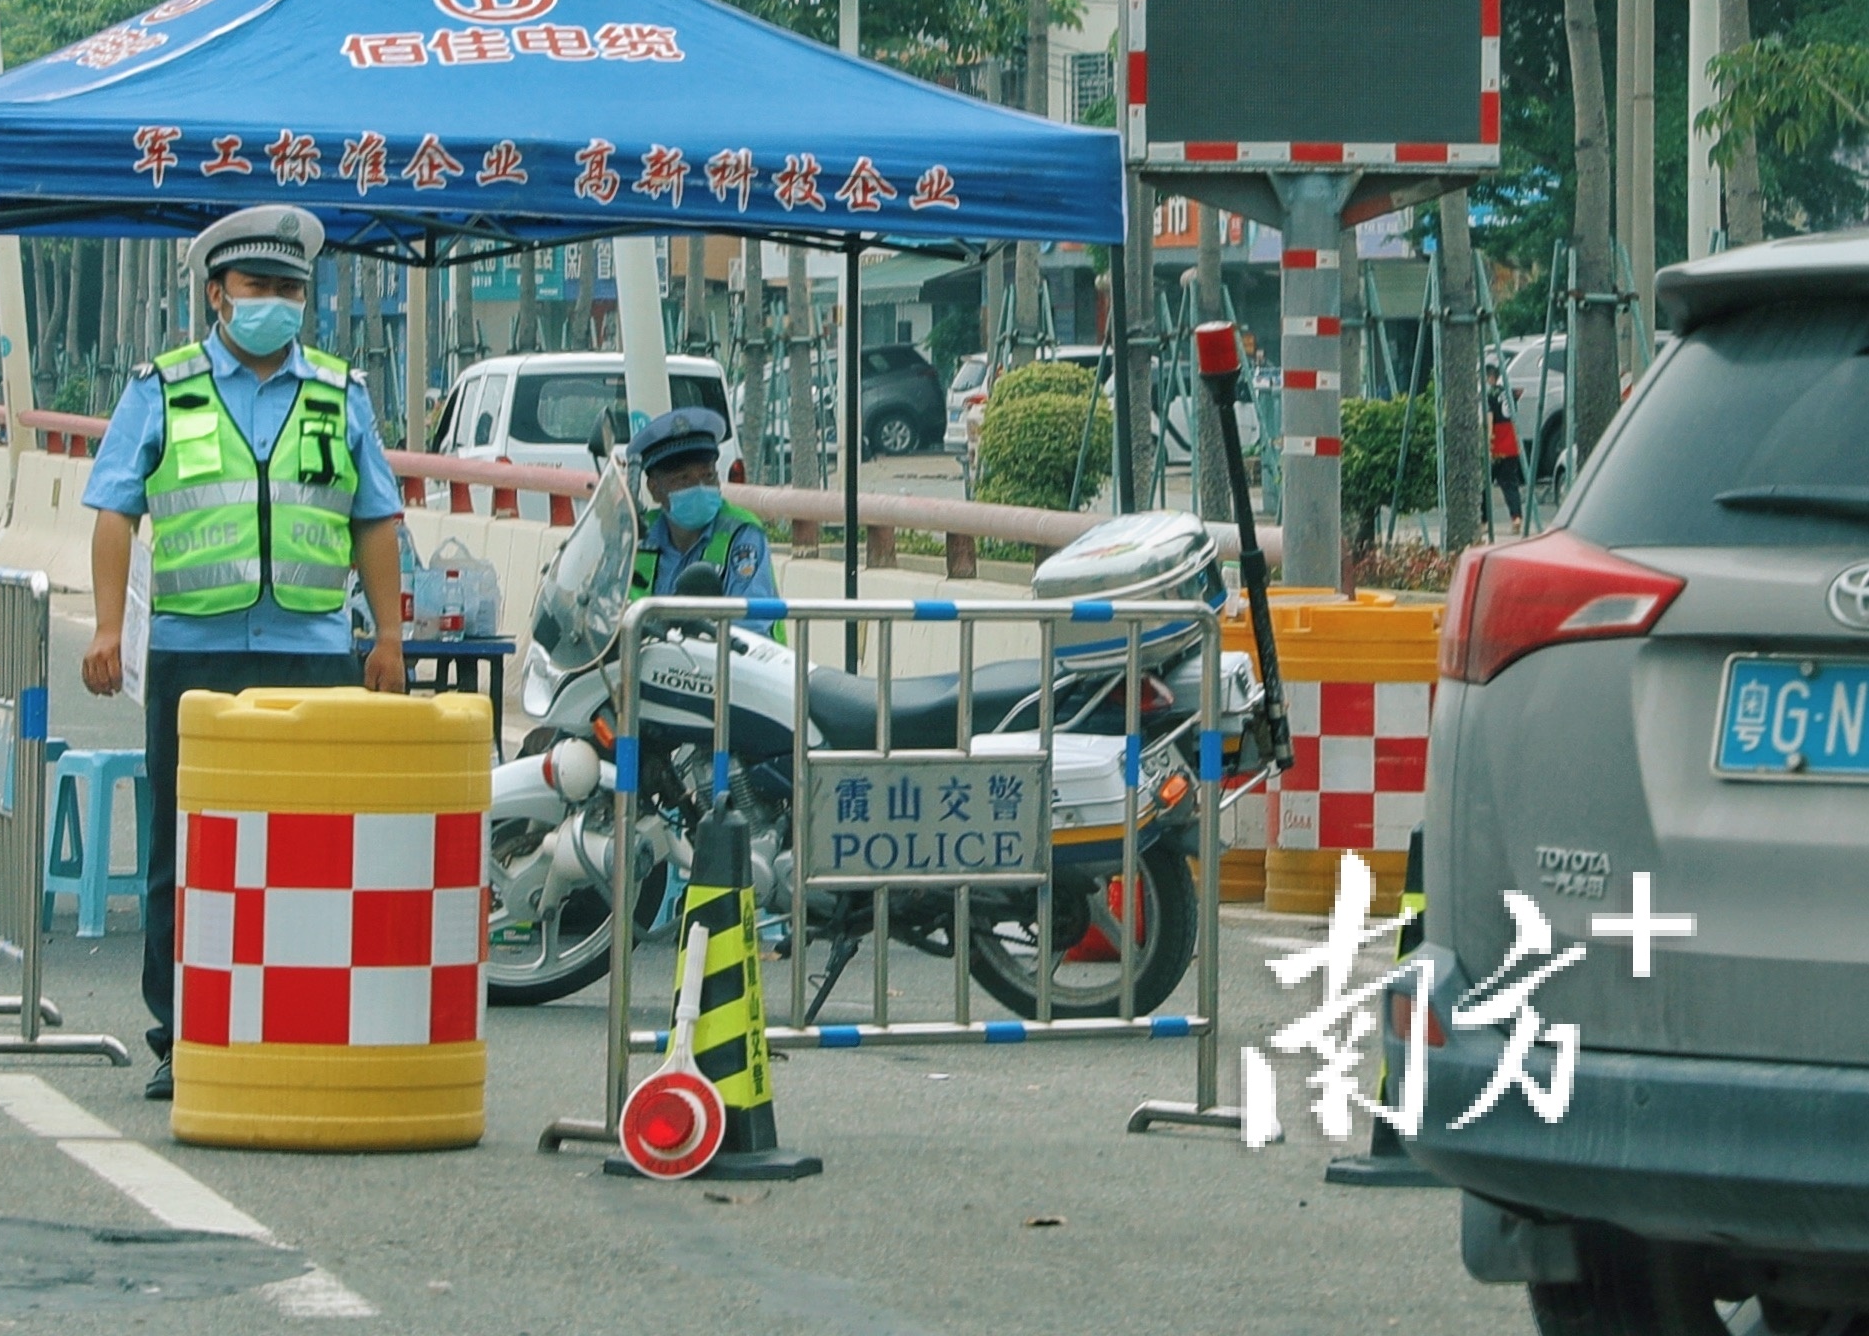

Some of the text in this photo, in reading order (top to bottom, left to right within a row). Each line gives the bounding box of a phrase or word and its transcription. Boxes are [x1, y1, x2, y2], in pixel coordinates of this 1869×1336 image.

[339, 23, 686, 69] 佰佳电缆
[133, 126, 961, 213] 军工标准企业 高新科技企业
[161, 520, 239, 557] POLICE
[650, 670, 718, 698] HOND
[834, 774, 1024, 824] 霞山交警
[830, 830, 1024, 871] POLICE
[1535, 845, 1612, 875] TOYOTA
